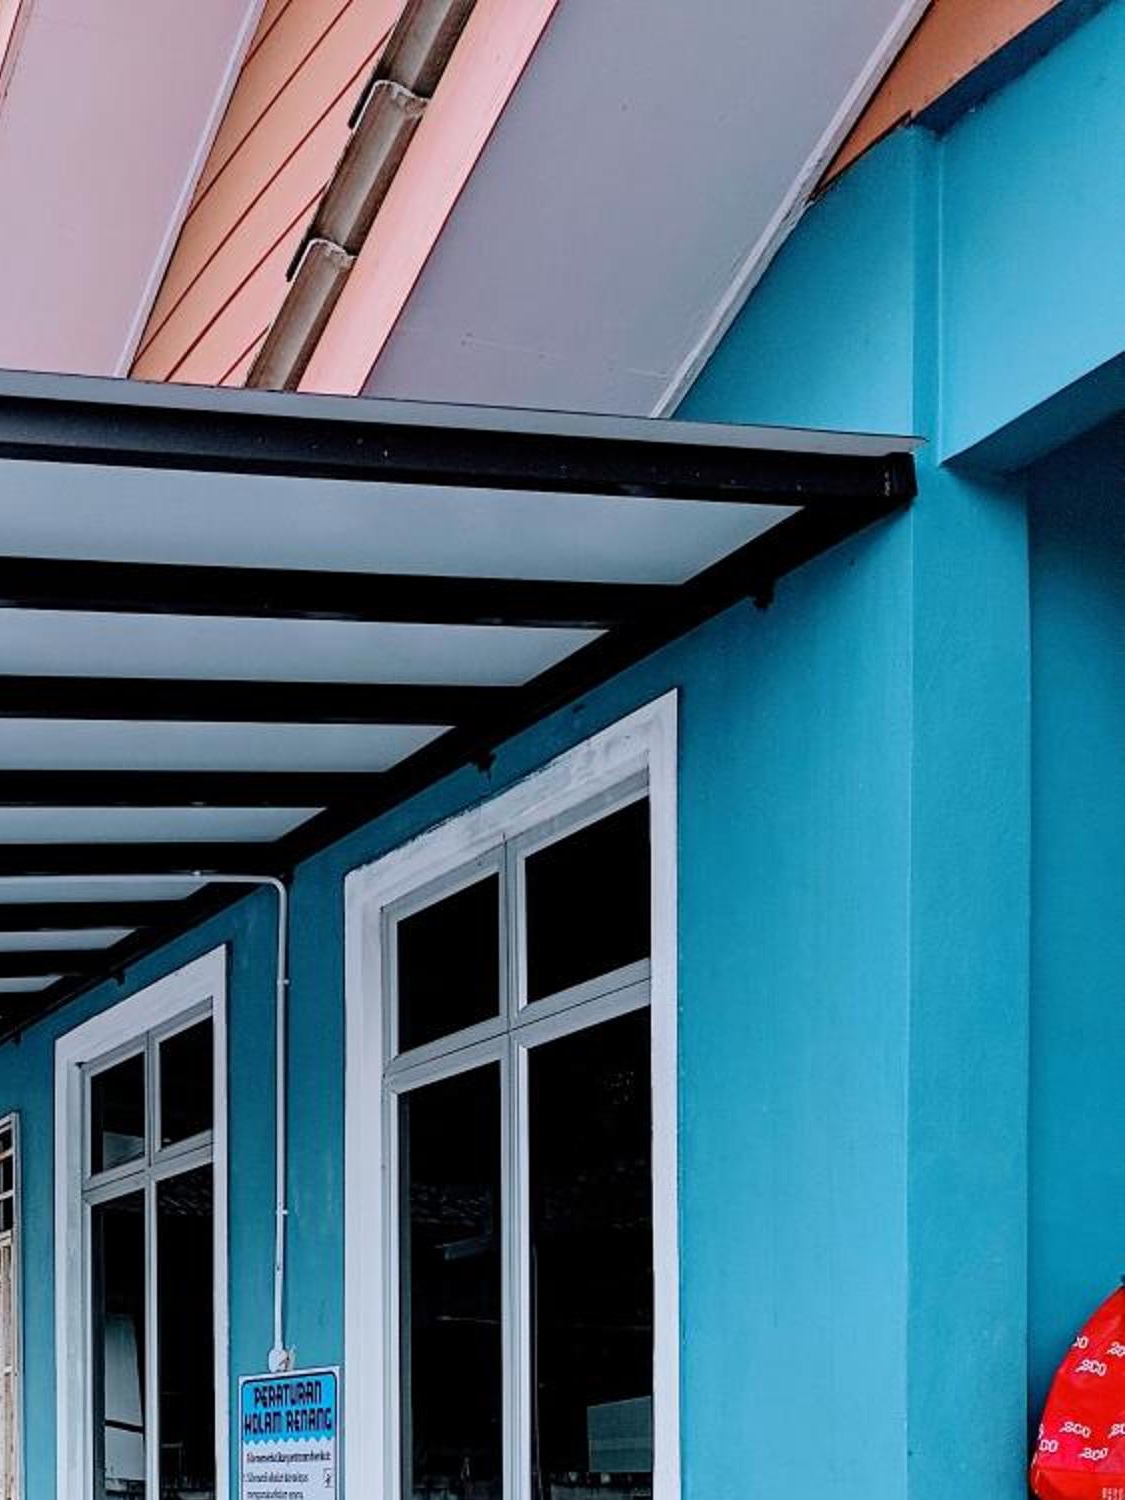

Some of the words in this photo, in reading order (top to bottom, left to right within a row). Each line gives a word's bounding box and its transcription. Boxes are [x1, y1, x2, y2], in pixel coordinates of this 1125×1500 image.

[254, 1380, 322, 1408] PERATURAN
[245, 1411, 282, 1434] KOLAM
[286, 1408, 331, 1432] RENANG
